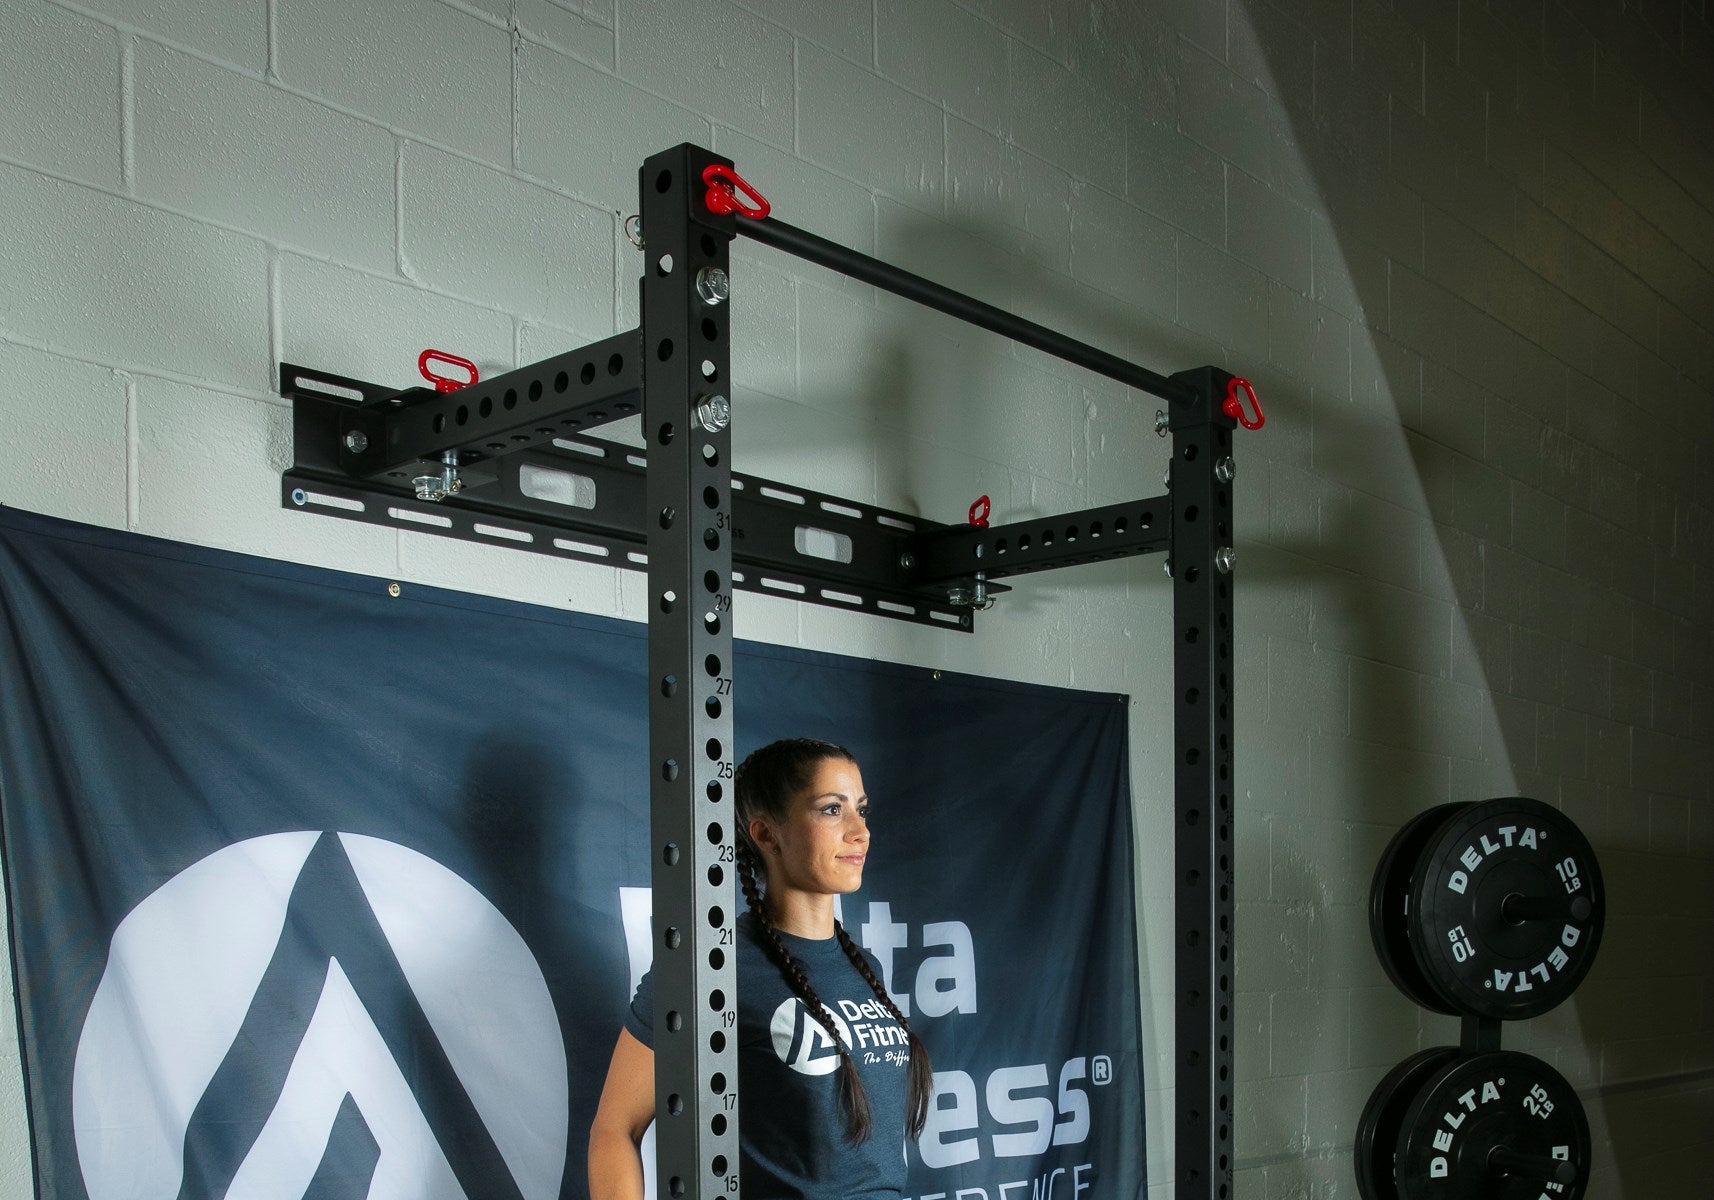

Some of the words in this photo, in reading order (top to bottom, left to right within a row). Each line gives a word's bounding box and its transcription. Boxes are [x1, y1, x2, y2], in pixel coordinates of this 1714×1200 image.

[716, 512, 731, 531] 31
[716, 678, 732, 695] 27
[717, 762, 733, 779] 25
[718, 845, 734, 862] 23
[1555, 857, 1578, 883] 10
[1564, 877, 1582, 894] LB
[719, 928, 734, 945] 21
[1448, 925, 1466, 943] LB
[1452, 937, 1476, 963] 10
[721, 1011, 736, 1028] 19
[853, 1023, 910, 1048] Fitne
[863, 1052, 882, 1066] The
[722, 1094, 737, 1111] 17
[1523, 1084, 1549, 1116] 25
[1538, 1101, 1555, 1119] LB
[724, 1176, 739, 1193] 15
